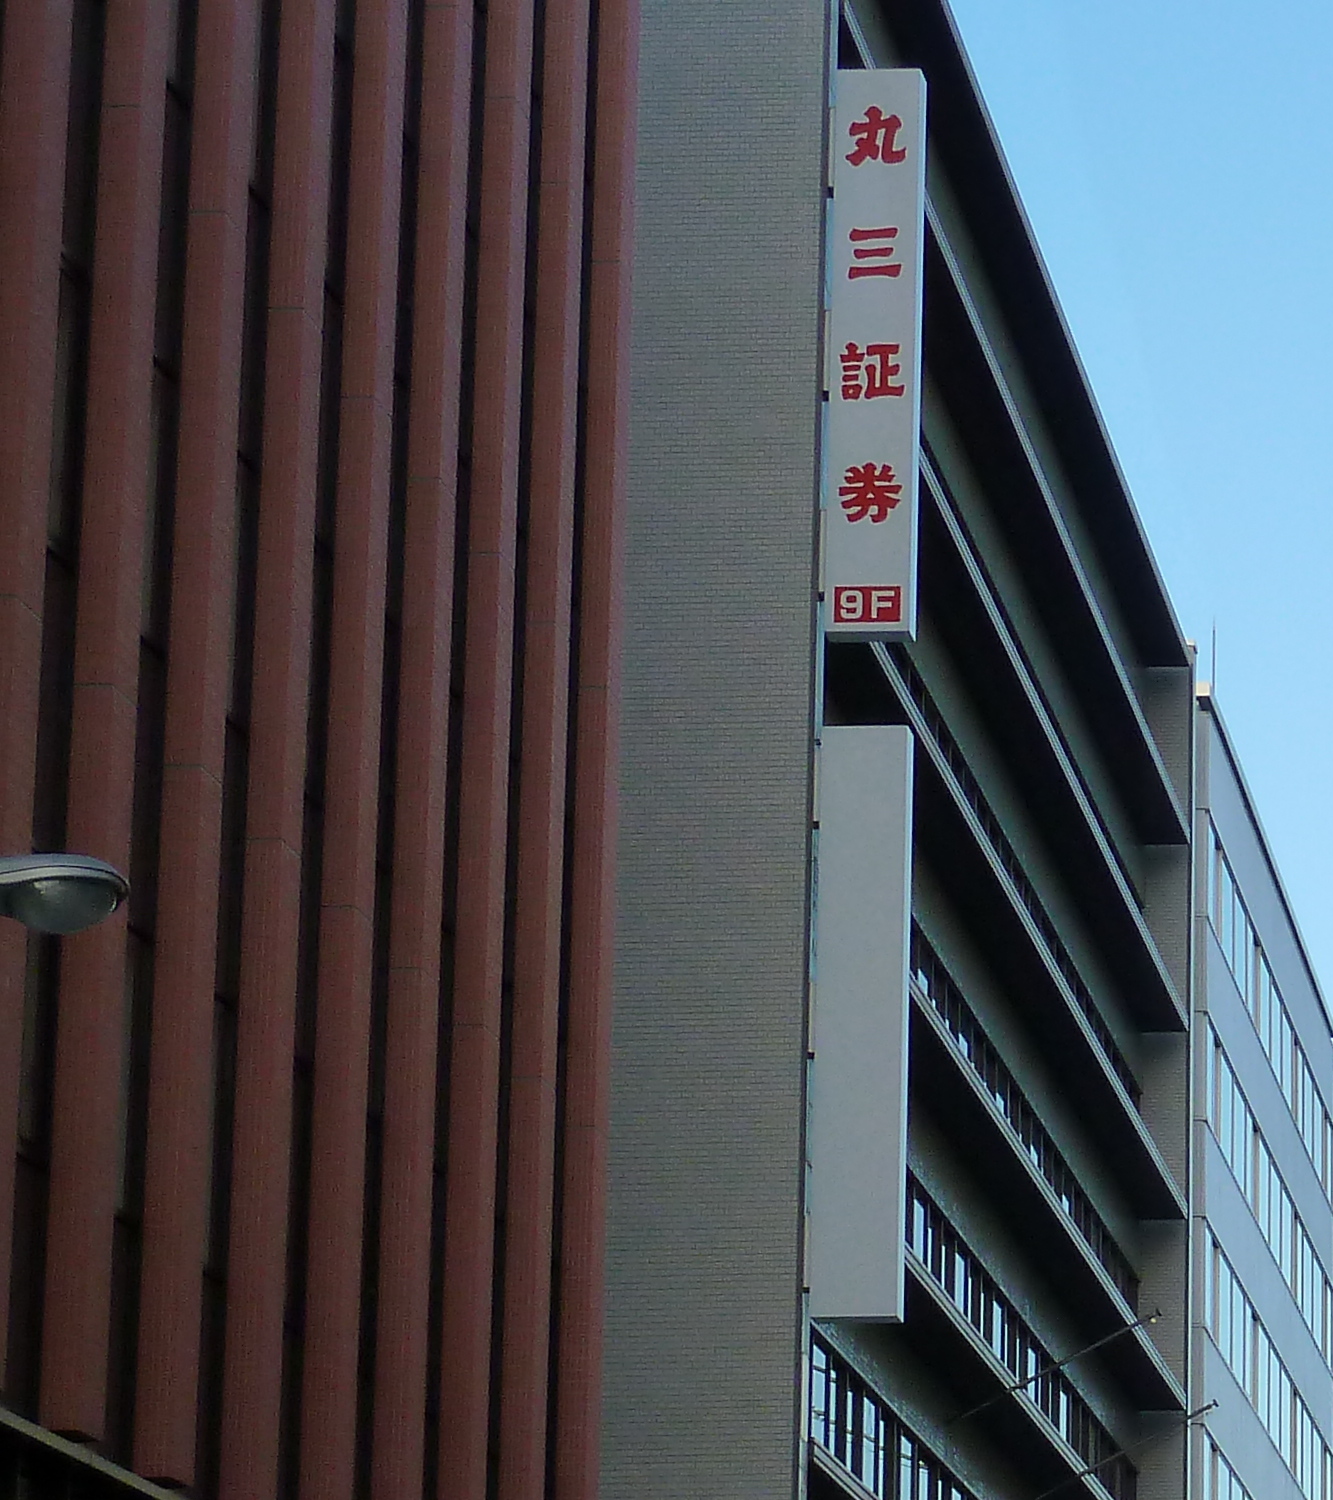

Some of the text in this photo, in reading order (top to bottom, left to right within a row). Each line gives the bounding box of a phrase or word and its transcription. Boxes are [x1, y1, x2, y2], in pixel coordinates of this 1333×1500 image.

[839, 104, 908, 525] 丸三証券
[839, 589, 896, 621] 9F
